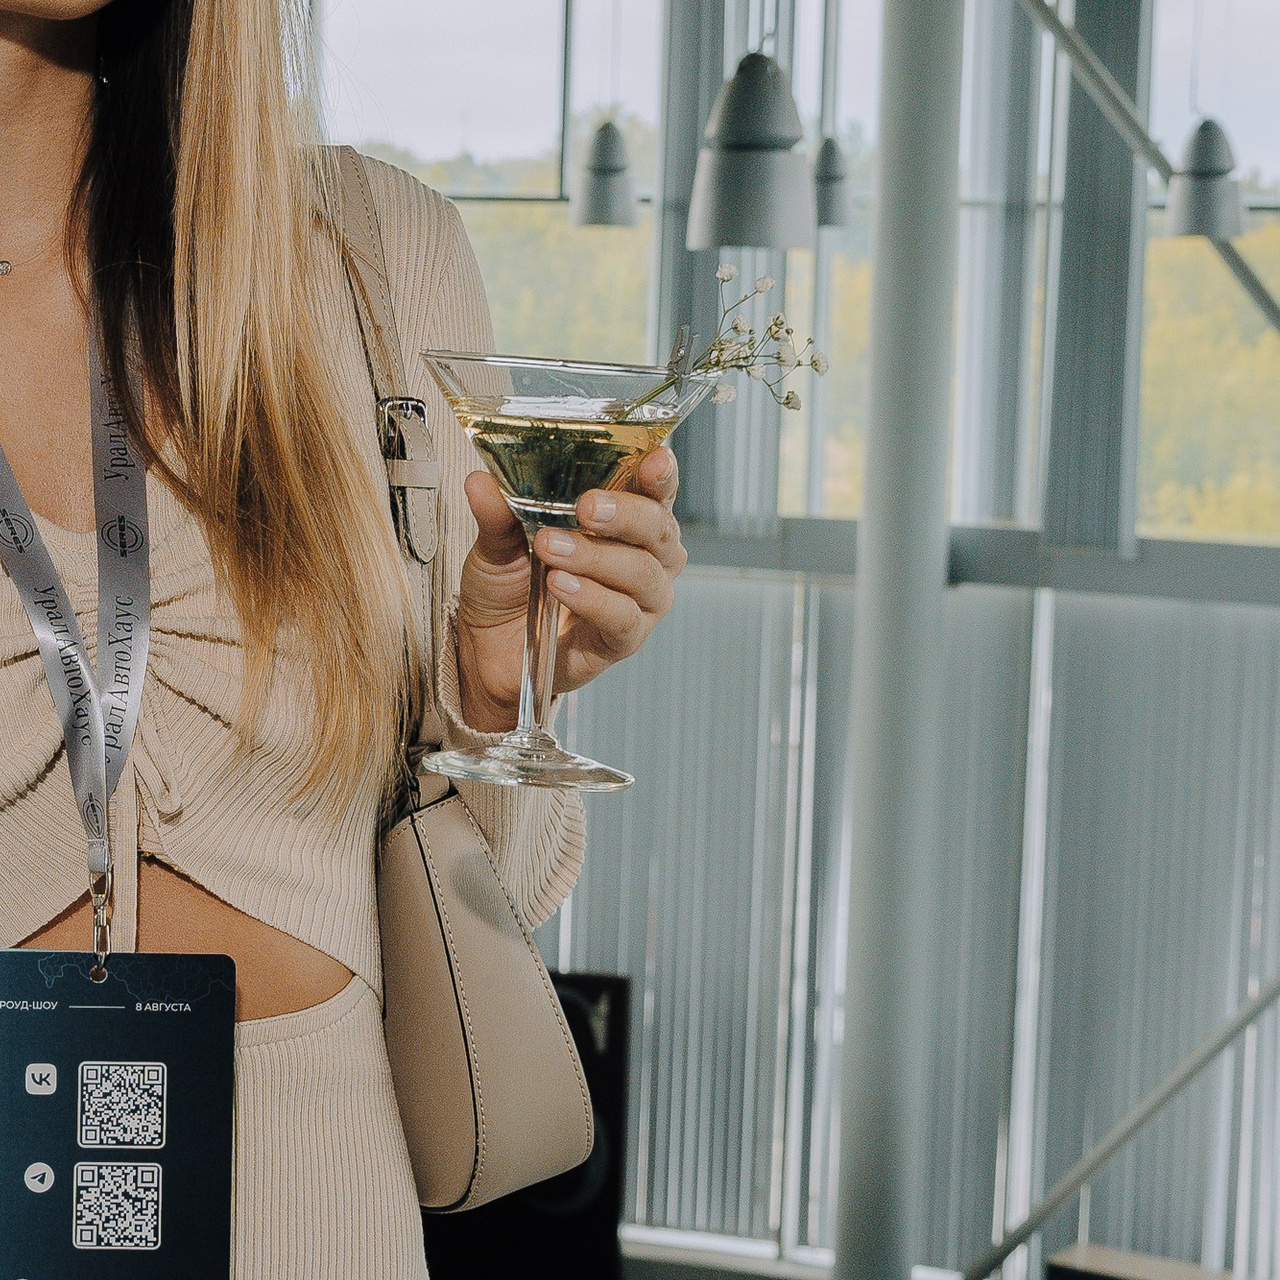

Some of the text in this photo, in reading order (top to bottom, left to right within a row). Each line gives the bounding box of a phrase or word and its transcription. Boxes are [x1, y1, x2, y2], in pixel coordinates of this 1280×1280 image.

[0, 508, 26, 554] SERES
[33, 584, 92, 747] УралАвтоХаус
[105, 595, 140, 764] ралАвтоХаус
[135, 1002, 142, 1012] 8
[144, 1003, 192, 1012] АВГУСТА
[31, 1072, 52, 1086] VK
